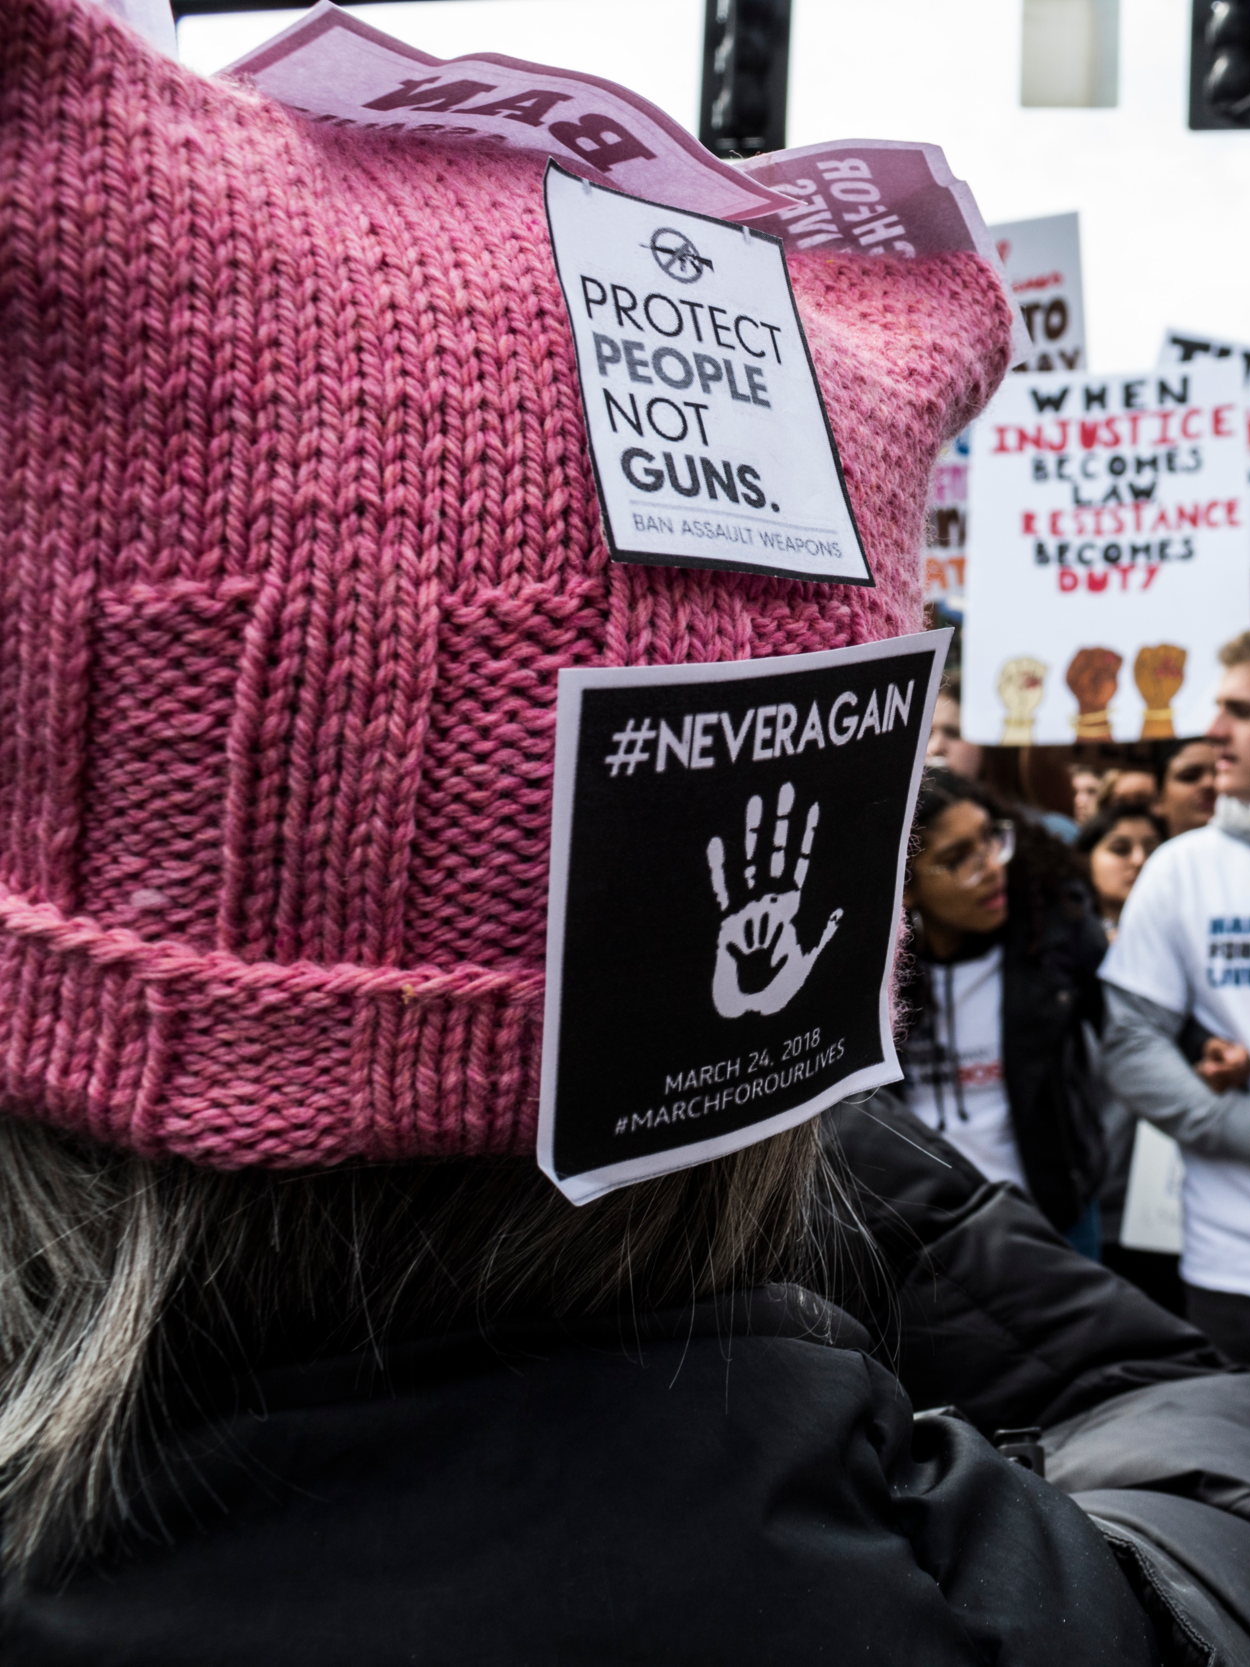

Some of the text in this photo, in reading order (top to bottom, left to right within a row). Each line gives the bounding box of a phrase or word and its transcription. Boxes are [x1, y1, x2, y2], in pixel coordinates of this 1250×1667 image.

[580, 274, 782, 365] PROTECT
[592, 330, 773, 410] PEOPLE
[1030, 375, 1190, 413] WHEN
[602, 387, 710, 447] NOT
[990, 405, 1237, 454] INJUSTICE
[620, 446, 781, 514] GUNS.
[1032, 448, 1202, 482] BECOMES
[1072, 480, 1158, 505] LAW
[633, 512, 843, 559] BAN ASSAULT WEAPONS
[1021, 498, 1242, 538] RESISTANCE
[1034, 537, 1195, 567] BECOMES
[1057, 564, 1161, 594] DUTY
[605, 680, 915, 778] #NEVERAGAIN
[613, 1037, 846, 1135] #MARCHFOROURLIVES
[664, 1057, 740, 1096] MARCH
[781, 1027, 821, 1061] 2018
